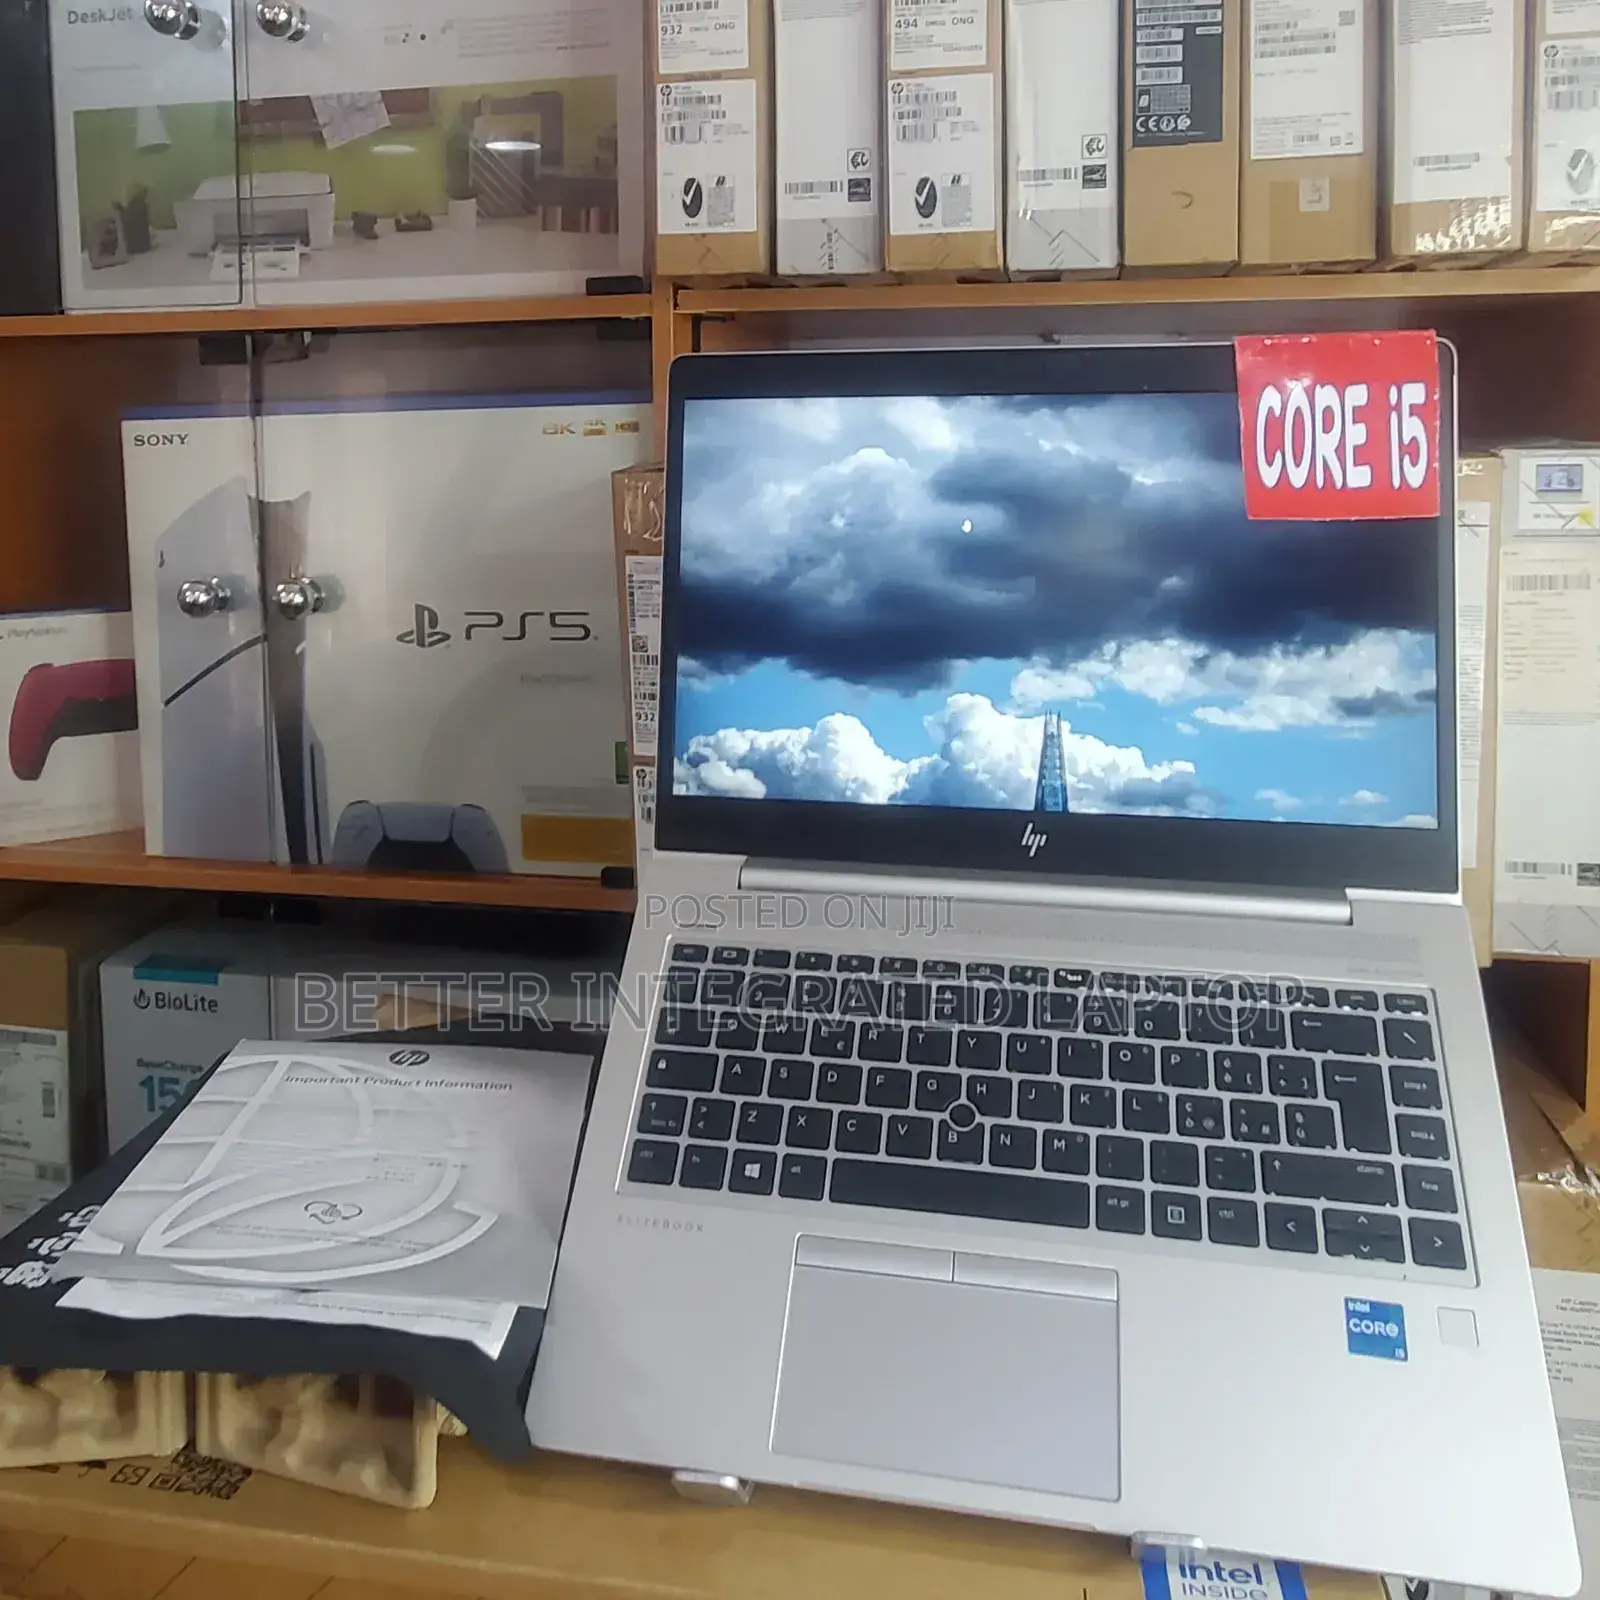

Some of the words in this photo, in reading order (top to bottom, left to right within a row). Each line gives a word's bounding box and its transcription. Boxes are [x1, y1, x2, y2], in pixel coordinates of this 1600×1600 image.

[67, 7, 133, 24] DeskJet
[660, 24, 683, 36] 932
[895, 18, 918, 29] 494
[133, 433, 189, 447] SONY
[1256, 380, 1372, 489] CORE
[1388, 382, 1428, 490] i5
[463, 611, 592, 641] PS5
[731, 1064, 742, 1075] A
[779, 1067, 788, 1079] S
[284, 1074, 360, 1086] Important
[363, 1075, 422, 1089] Product
[424, 1078, 514, 1092] Information
[827, 1070, 838, 1083] D
[926, 1079, 938, 1091] G
[976, 1083, 987, 1095] H
[1079, 1092, 1091, 1105] K
[747, 1109, 758, 1123] Z
[796, 1114, 807, 1127] X
[846, 1119, 857, 1132] C
[897, 1122, 909, 1136] V
[1000, 1132, 1011, 1146] N
[1053, 1138, 1066, 1151] M
[1178, 1557, 1264, 1587] intel
